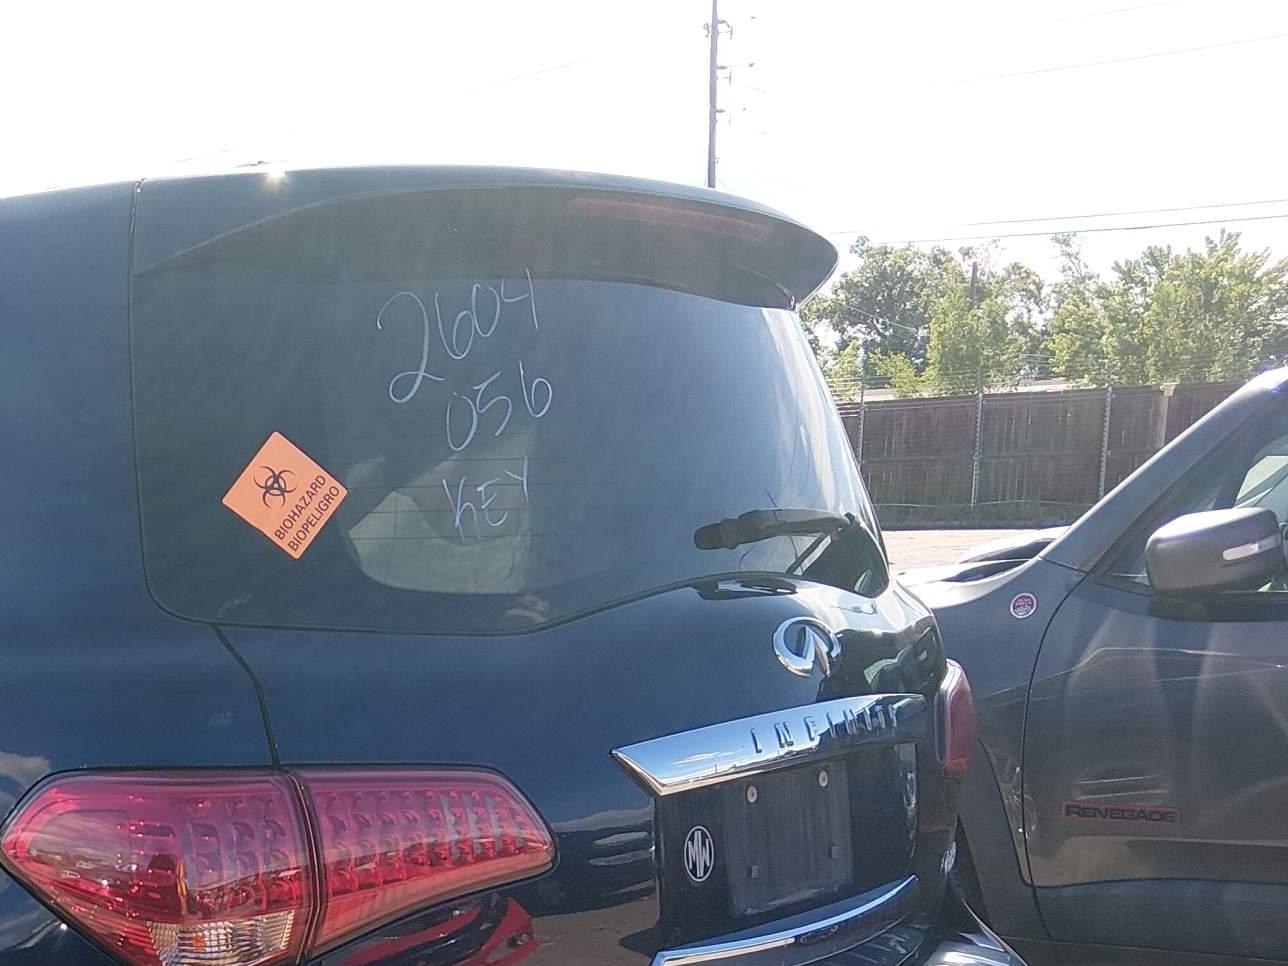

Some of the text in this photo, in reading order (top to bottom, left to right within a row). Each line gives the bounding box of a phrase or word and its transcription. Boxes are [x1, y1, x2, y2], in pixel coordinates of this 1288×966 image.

[376, 267, 540, 404] 2604
[446, 359, 553, 452] 056
[274, 474, 326, 541] BIOHAZARD
[287, 486, 340, 552] BIOPELIGRO
[442, 455, 530, 544] KEY
[1065, 803, 1177, 822] RENEGADE
